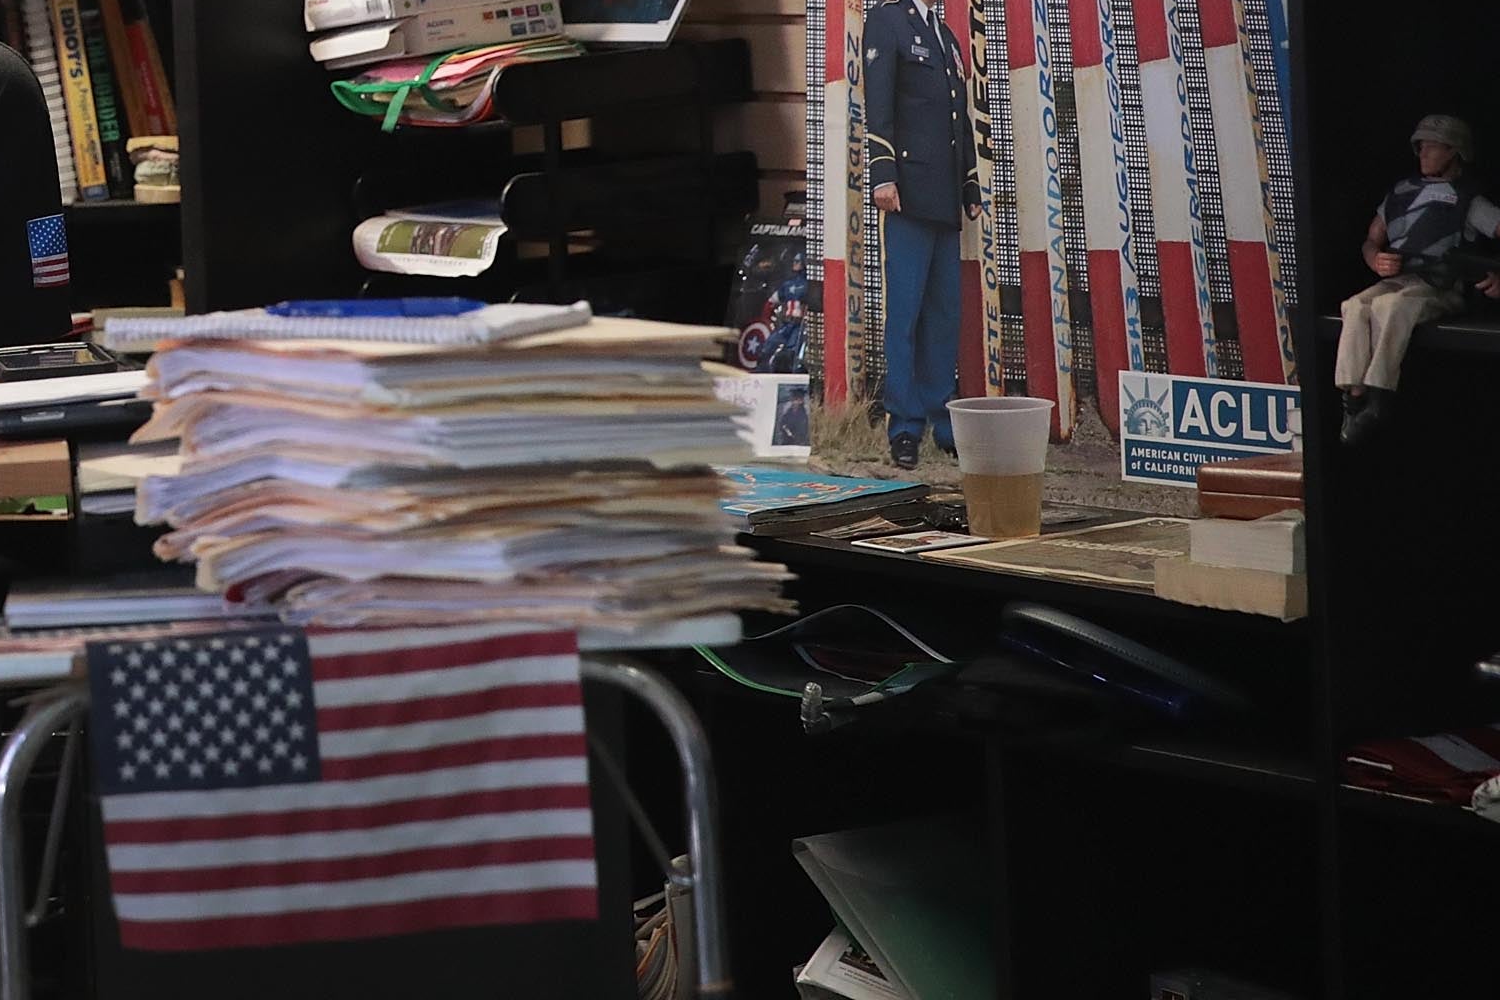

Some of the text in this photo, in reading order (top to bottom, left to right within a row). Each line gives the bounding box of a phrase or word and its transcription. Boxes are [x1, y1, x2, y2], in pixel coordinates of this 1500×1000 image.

[60, 8, 84, 79] IDIOT'S
[750, 223, 787, 237] CAPTAIN
[979, 178, 1003, 386] PETE O'NEAL
[1045, 147, 1073, 374] FERNANDO
[1178, 388, 1294, 444] ACLU
[1131, 447, 1181, 461] AMERICAN
[1183, 452, 1209, 464] CIVIL
[1131, 460, 1196, 476] of CALIFORNI
